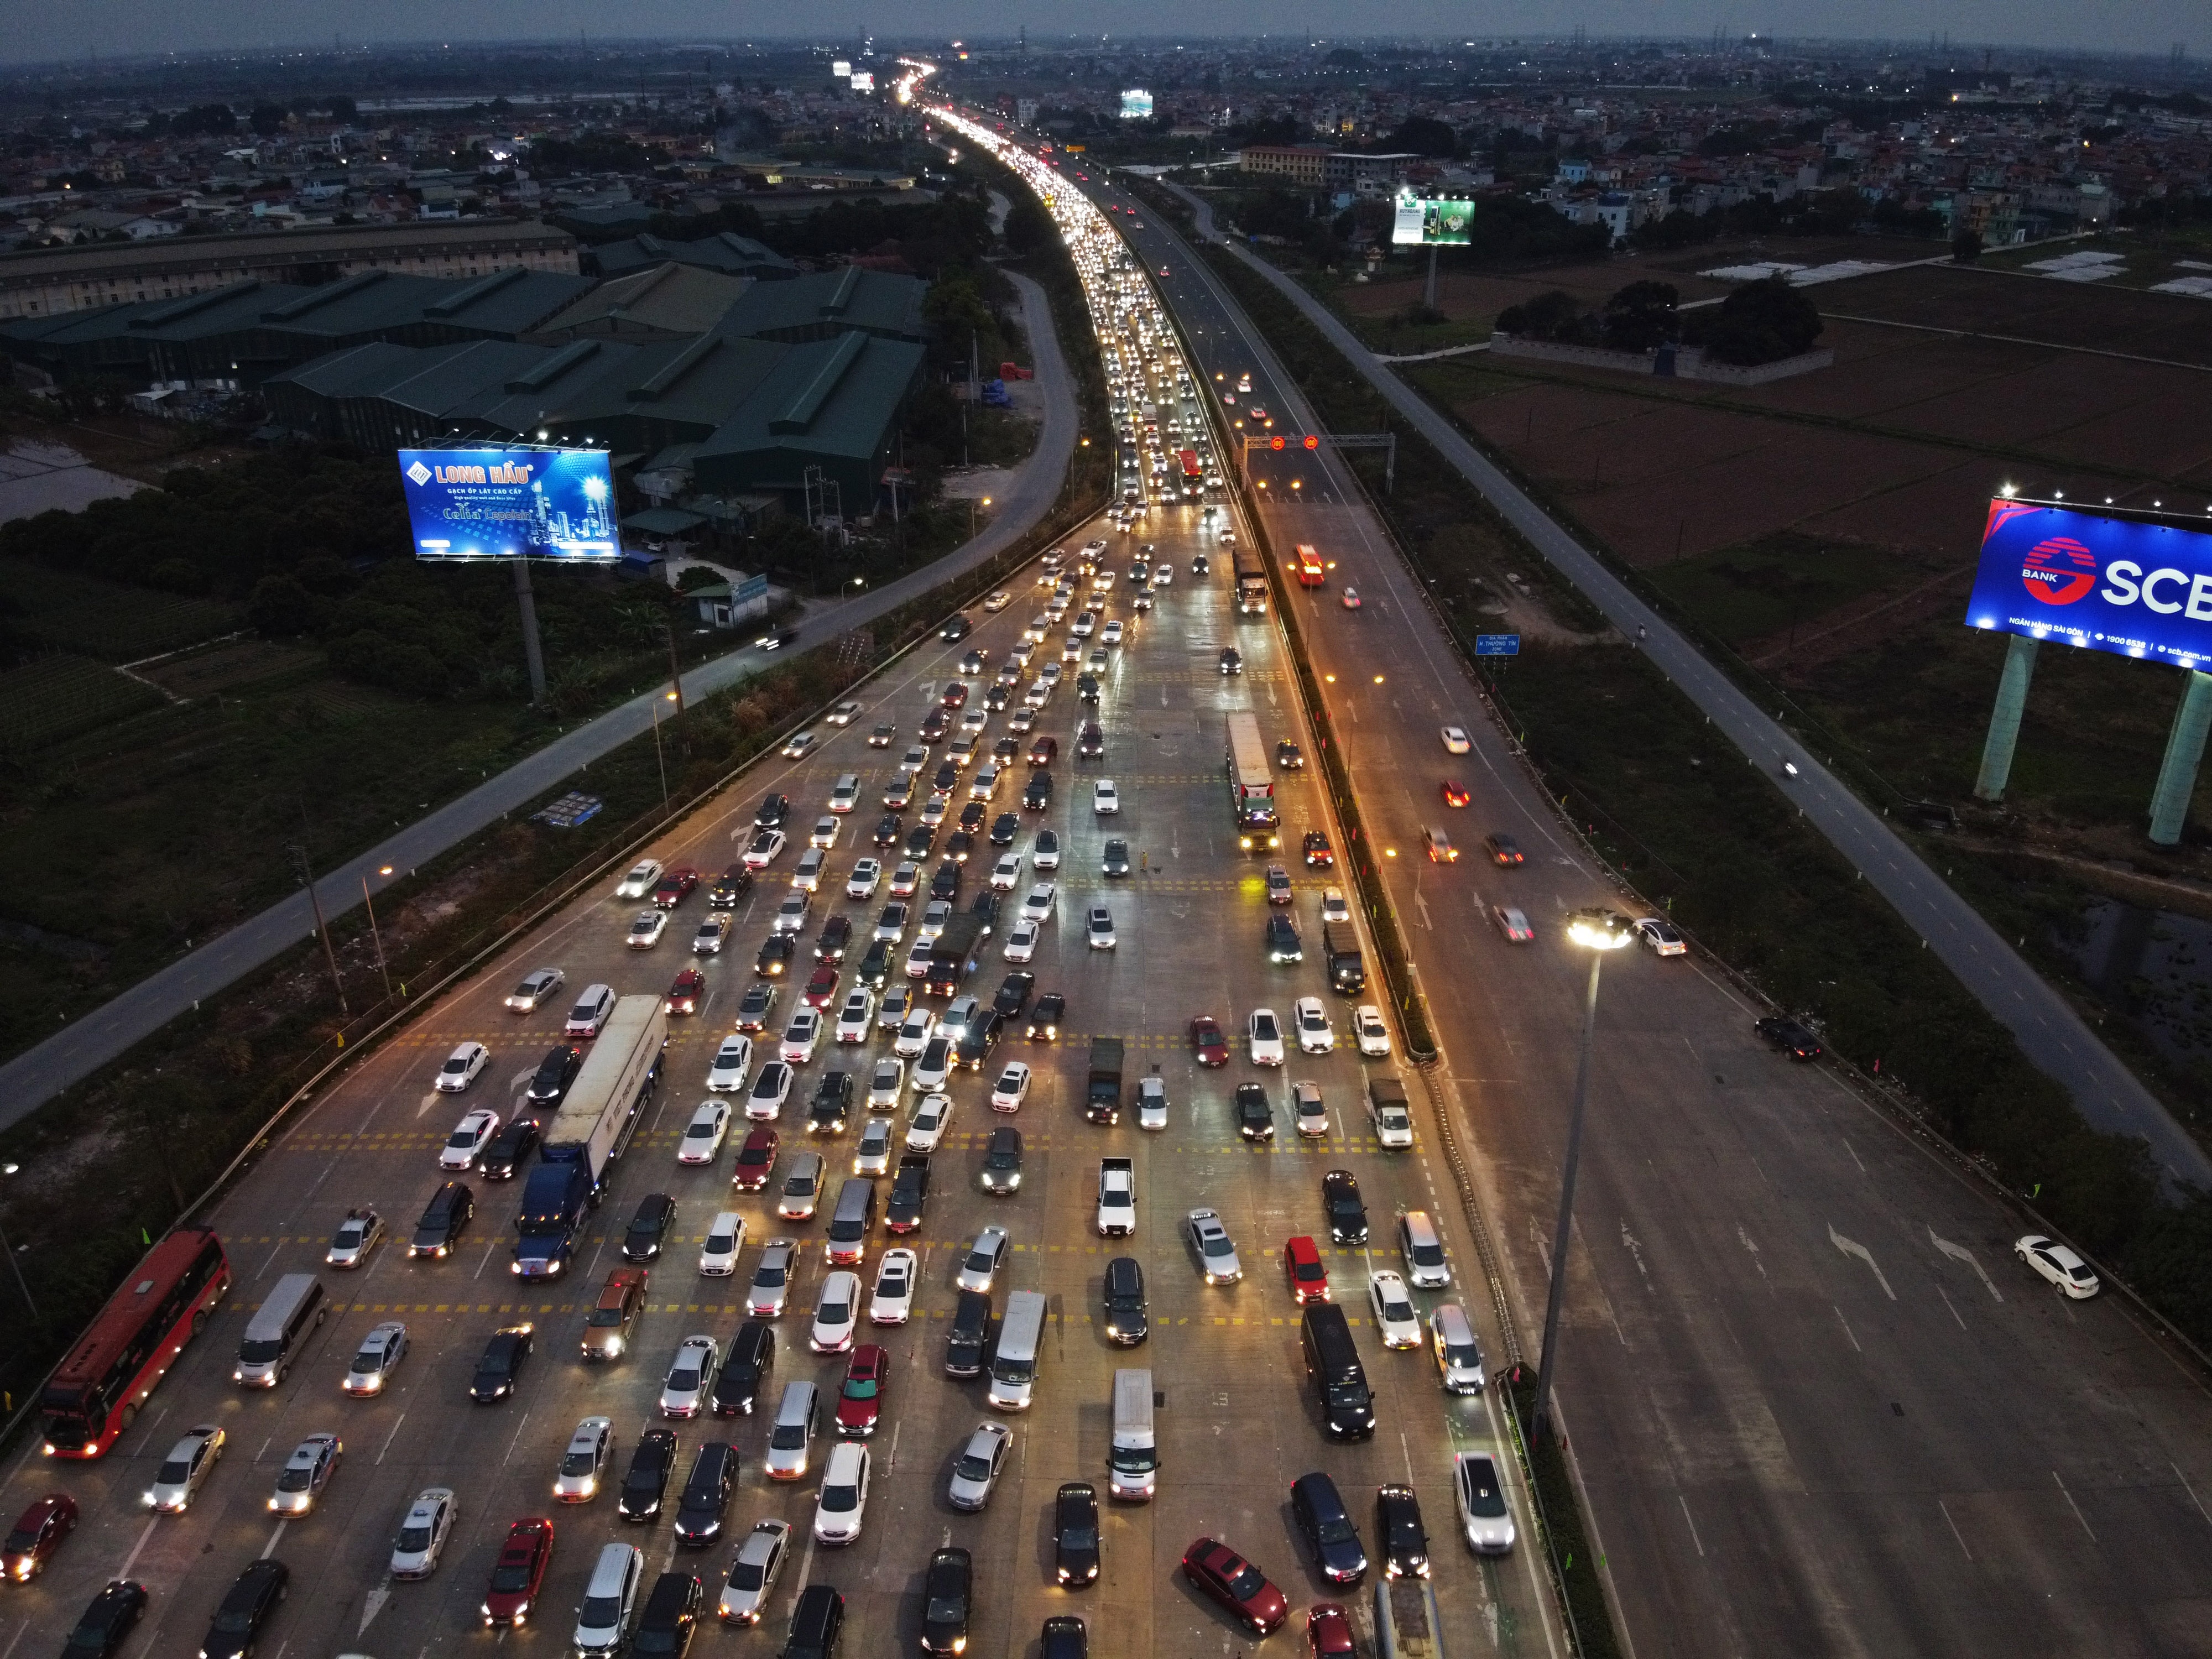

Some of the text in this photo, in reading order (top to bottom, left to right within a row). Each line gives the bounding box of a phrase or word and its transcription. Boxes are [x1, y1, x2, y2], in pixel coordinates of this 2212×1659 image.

[435, 466, 487, 484] LONG
[443, 507, 481, 520] Celia
[2022, 568, 2058, 583] BANK
[2101, 560, 2212, 622] SCB
[2008, 617, 2211, 662] NGÂN HÀNG SÀI GÒN 1900 6538 scb.com.vn
